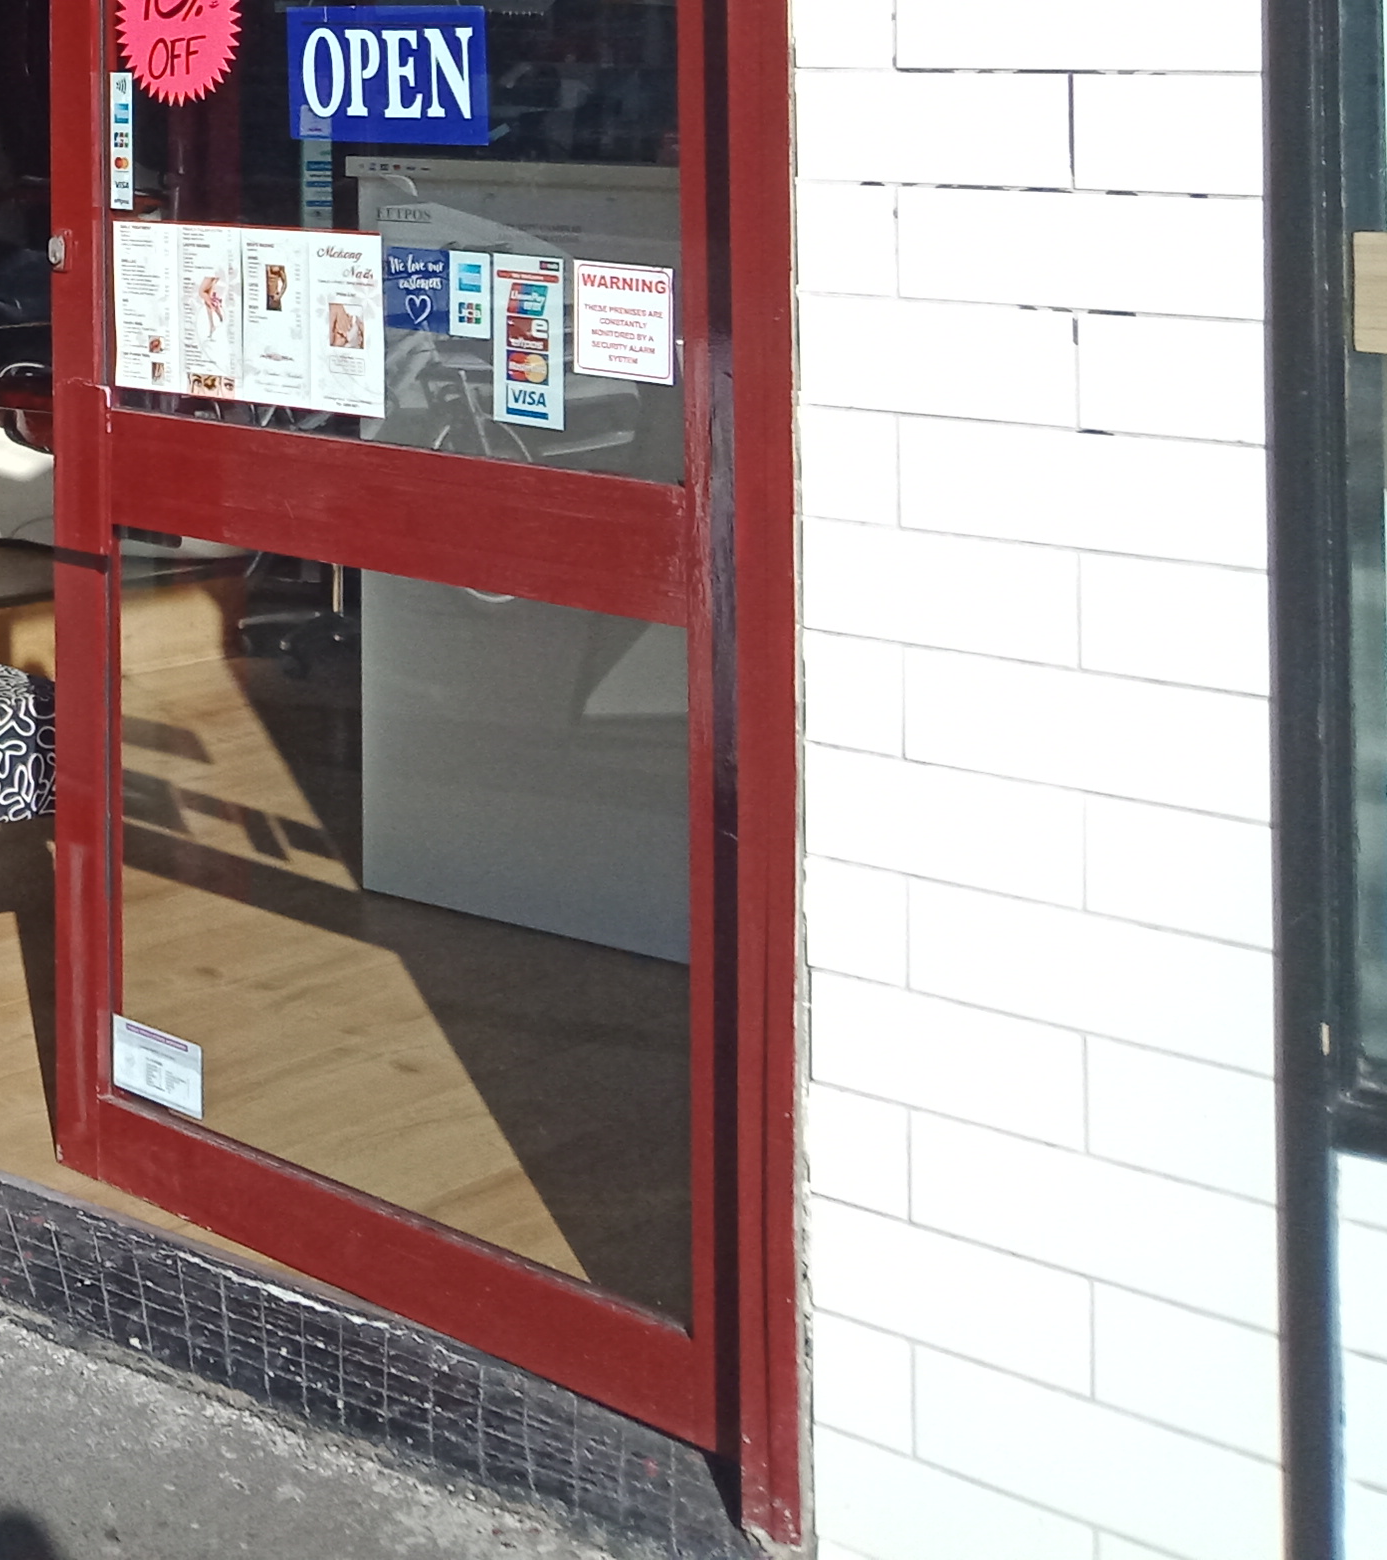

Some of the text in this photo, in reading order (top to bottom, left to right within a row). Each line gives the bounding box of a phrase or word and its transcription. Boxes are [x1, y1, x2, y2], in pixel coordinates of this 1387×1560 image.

[148, 35, 207, 80] OFF
[302, 27, 473, 120] OPEN
[389, 256, 405, 274] We
[582, 273, 667, 294] WARNING
[511, 388, 547, 408] VISA
